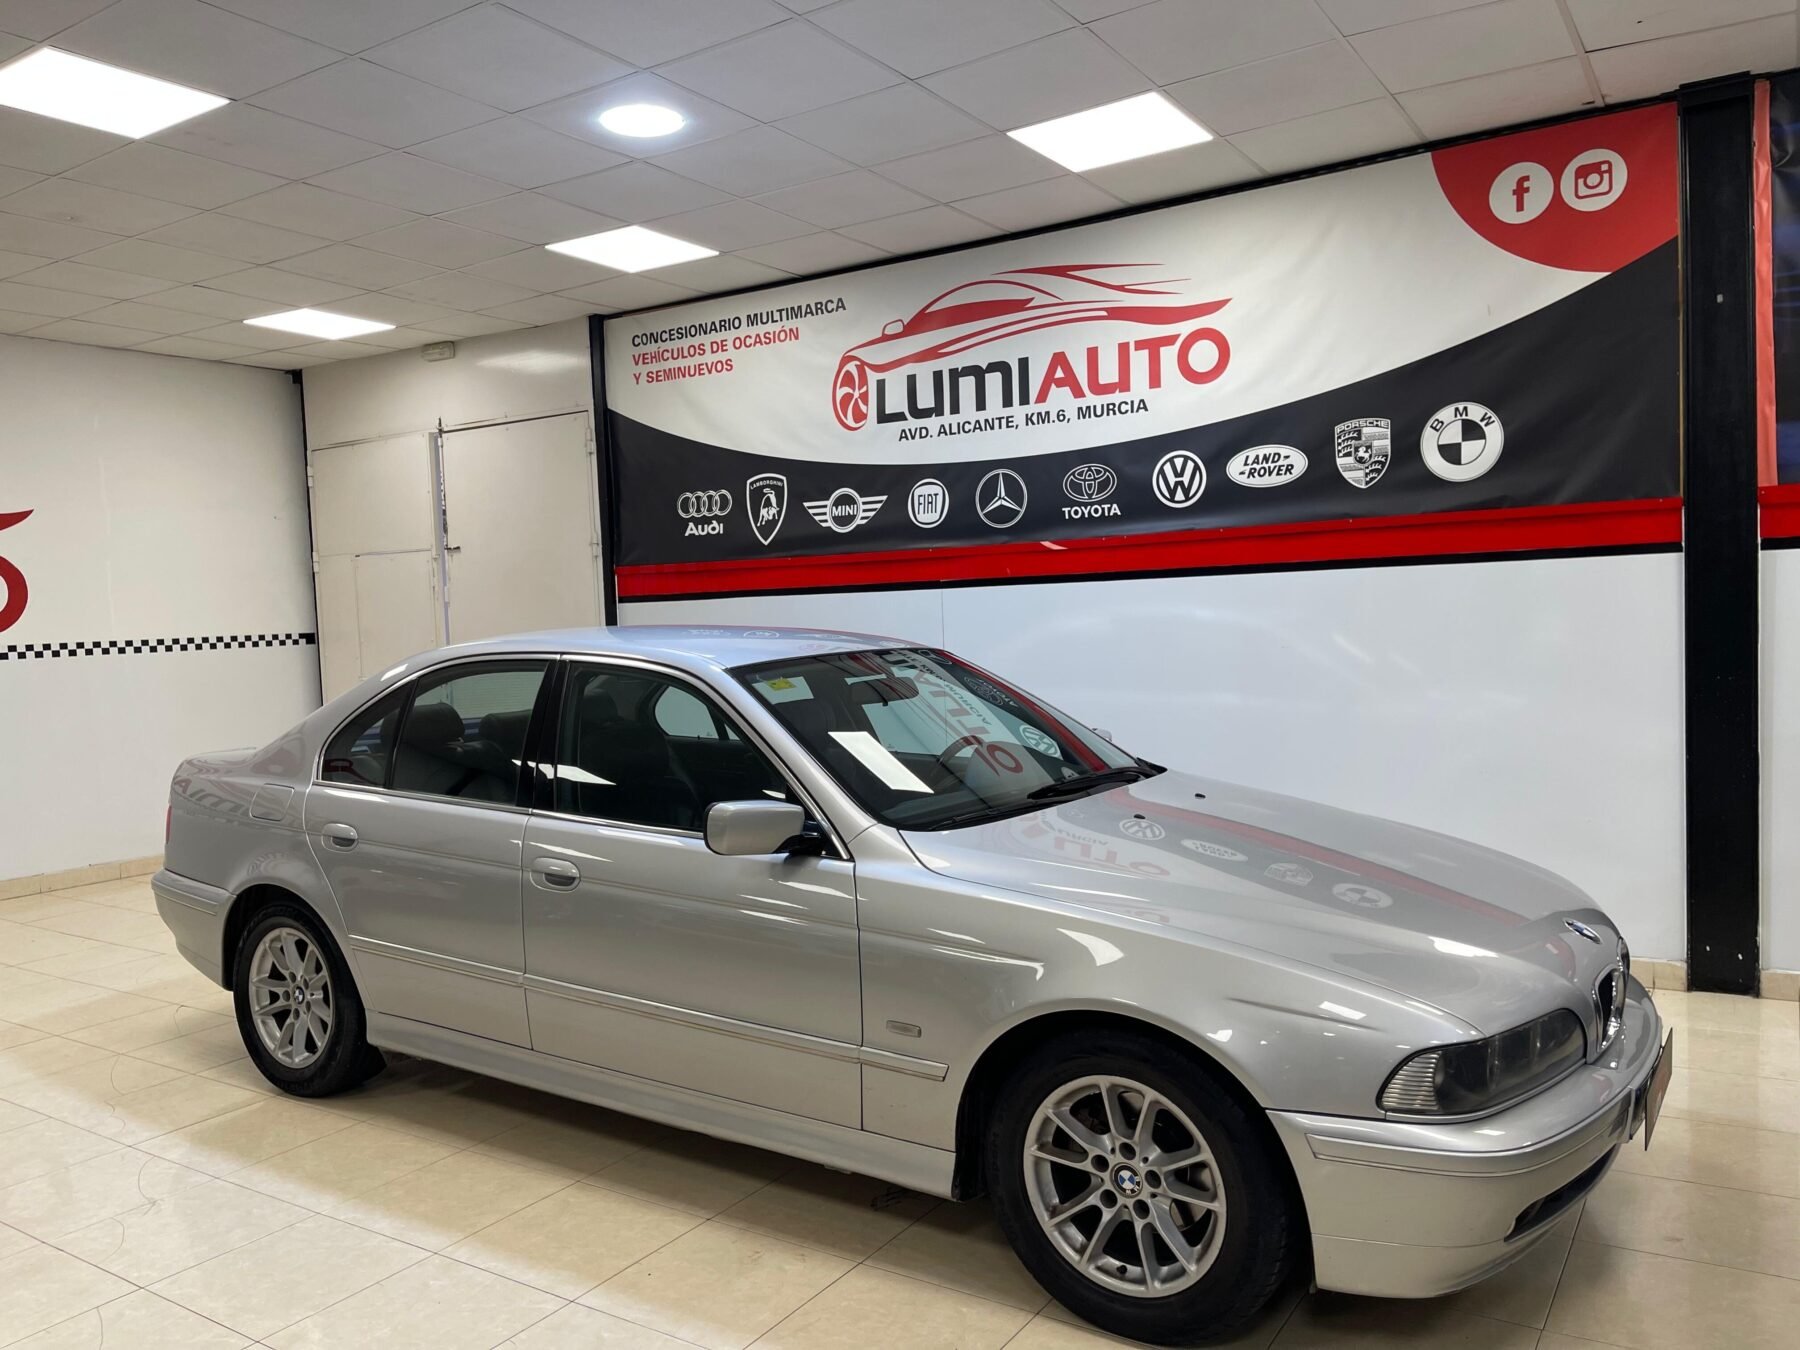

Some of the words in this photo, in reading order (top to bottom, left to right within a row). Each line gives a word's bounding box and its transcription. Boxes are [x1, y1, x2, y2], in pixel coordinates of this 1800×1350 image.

[632, 316, 742, 348] CONCESIONARIO
[746, 298, 846, 328] MULTIMARCA
[632, 341, 706, 367] VEHÍCULOS
[710, 340, 728, 354] DE
[733, 326, 800, 350] OCASIÓN
[633, 371, 641, 385] Y
[646, 358, 734, 384] SEMINUEVOS
[898, 421, 934, 442] AVD.
[937, 415, 1020, 438] ALICANTE,
[1025, 408, 1072, 428] KM.6,
[1077, 398, 1149, 422] MURCIA
[1337, 419, 1390, 434] PORSCHE
[1430, 406, 1495, 433] BMW
[750, 479, 783, 490] LAMBORGHINI
[832, 505, 858, 517] MINI
[917, 493, 939, 515] FIAT
[1062, 503, 1122, 519] TOYOTA
[685, 520, 724, 536] Audi
